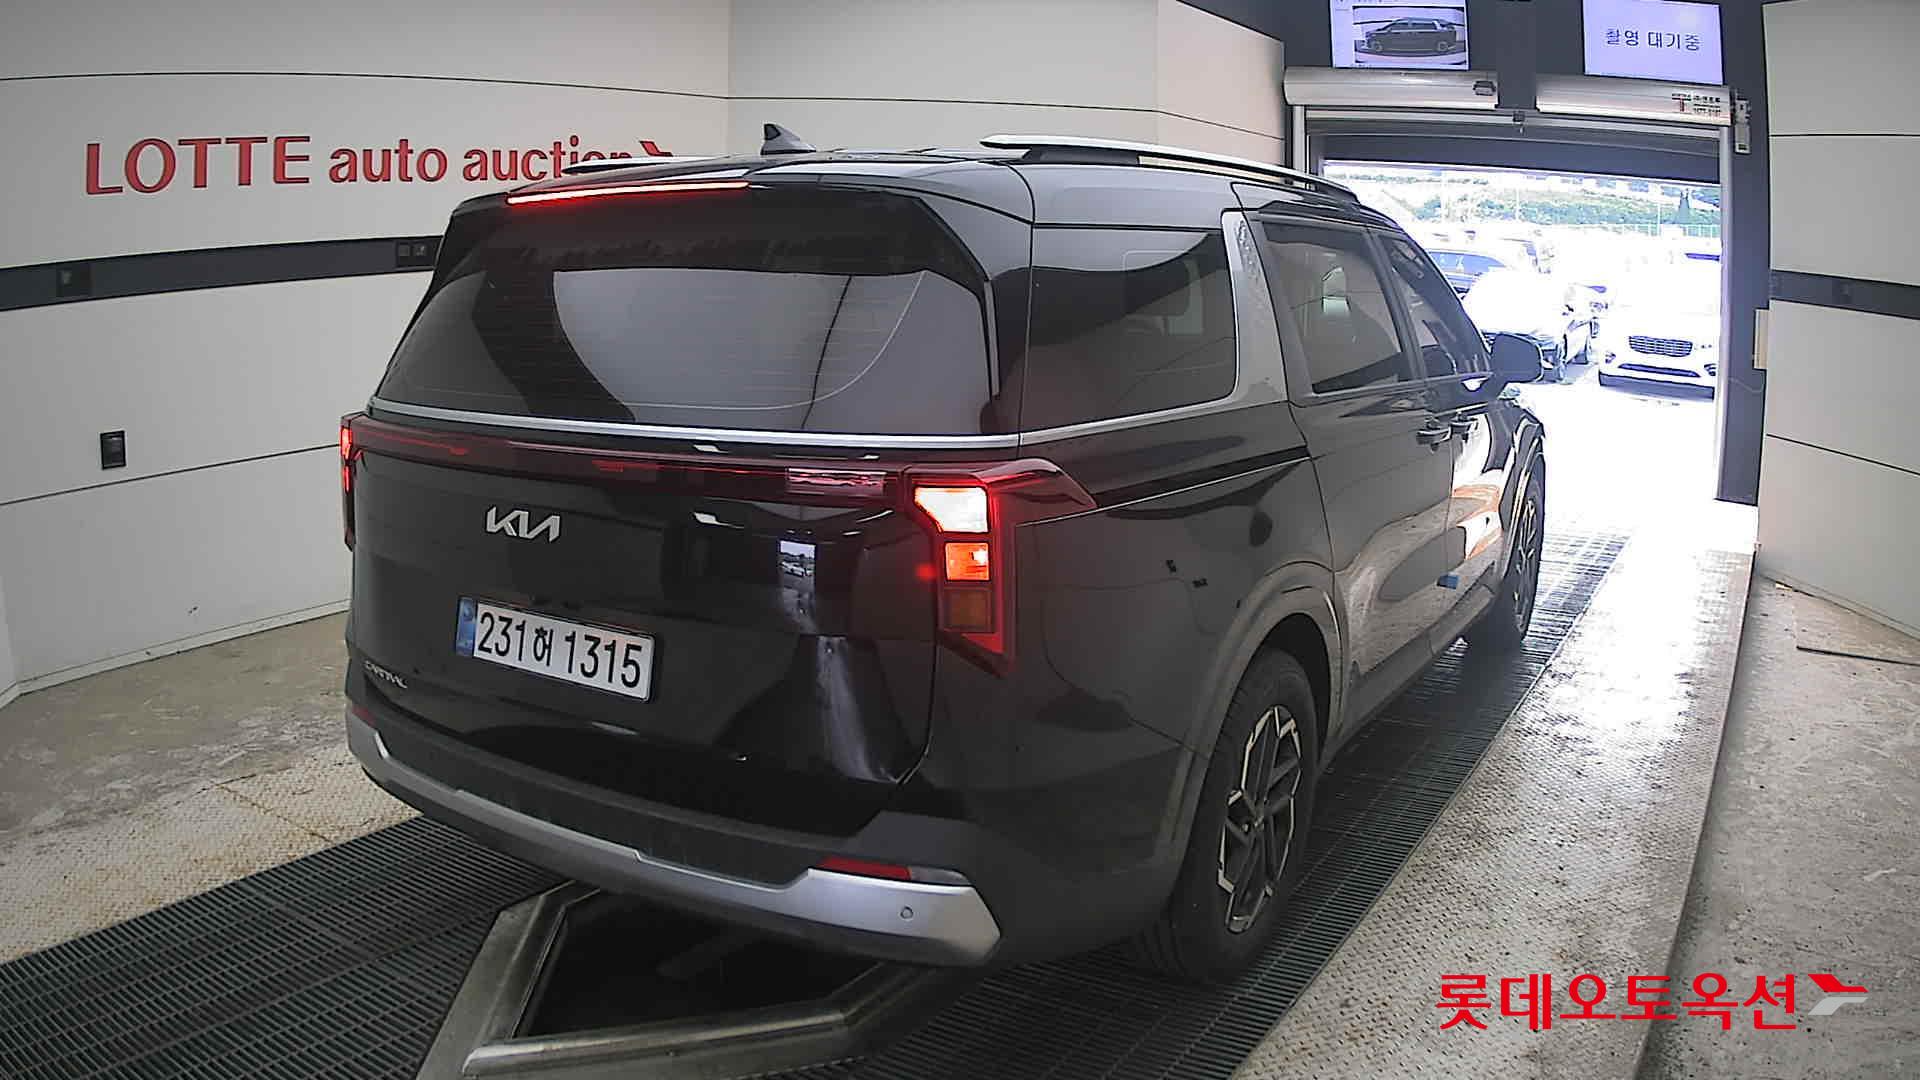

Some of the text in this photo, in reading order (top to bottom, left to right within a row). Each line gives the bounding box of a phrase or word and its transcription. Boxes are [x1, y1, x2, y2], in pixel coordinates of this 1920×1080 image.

[1647, 31, 1700, 51] 대기중
[86, 135, 633, 195] LOTTE auto aucti
[478, 611, 644, 689] 231허 1315
